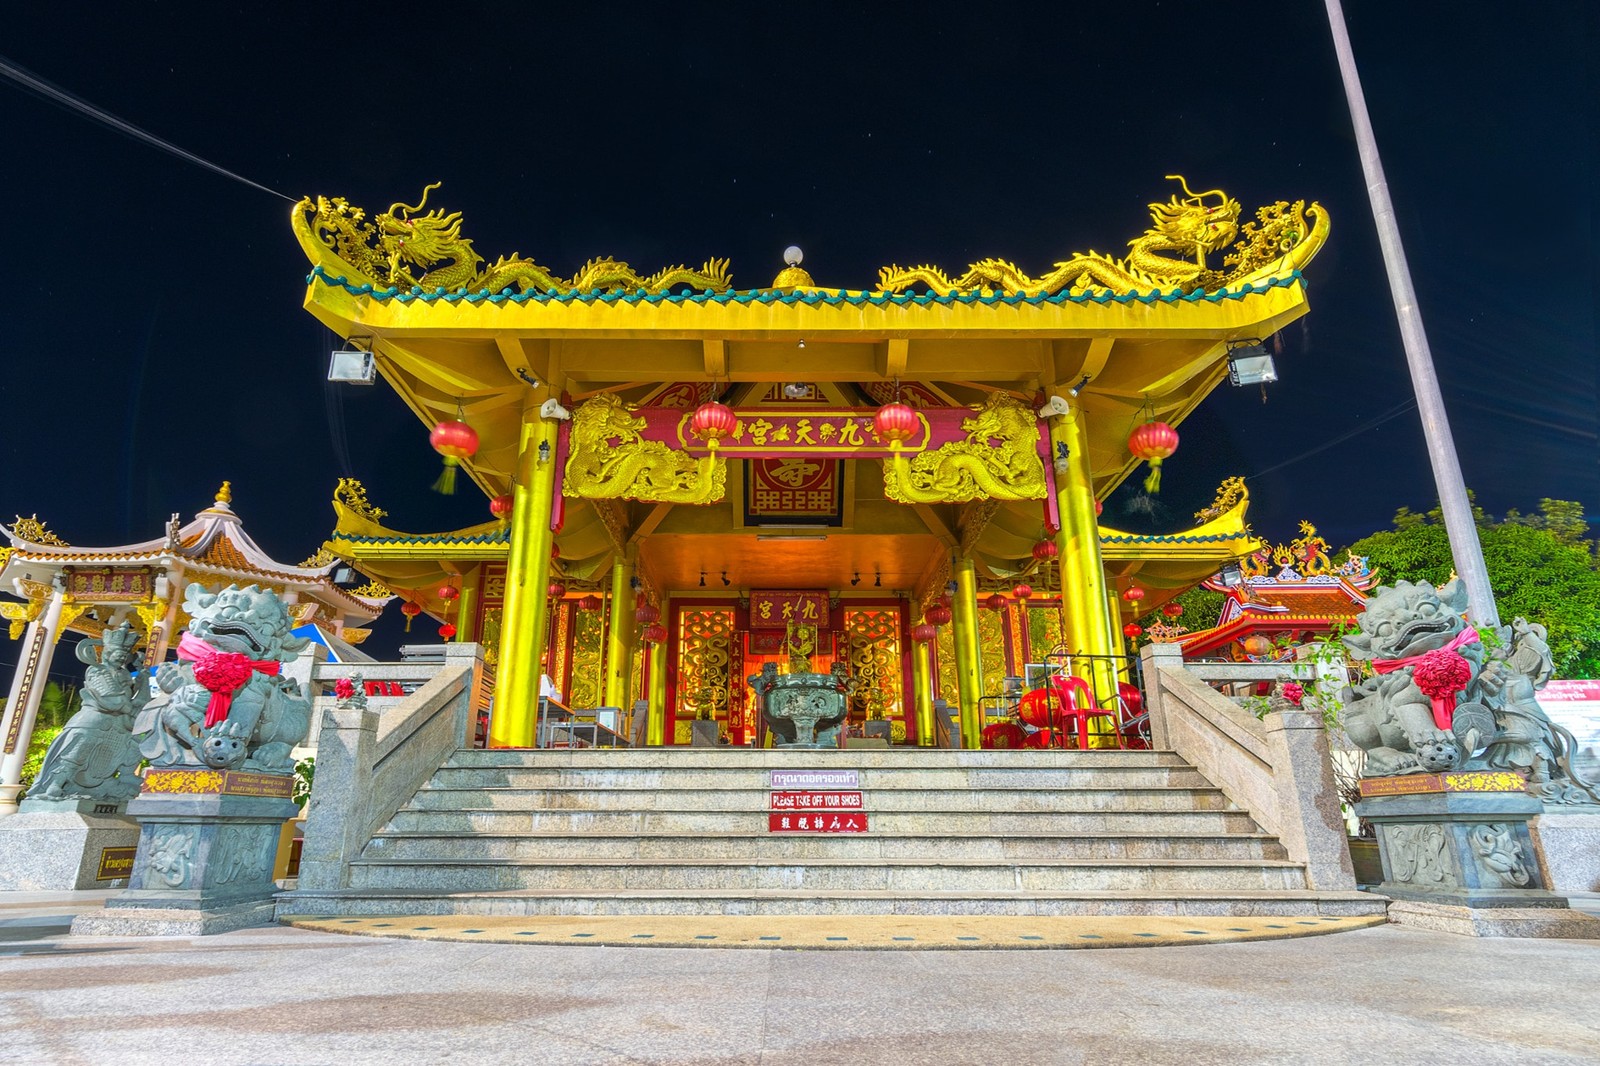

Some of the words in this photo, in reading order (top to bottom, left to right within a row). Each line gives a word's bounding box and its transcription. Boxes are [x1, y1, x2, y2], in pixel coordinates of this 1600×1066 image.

[773, 795, 795, 806] PLEASE
[795, 795, 811, 806] TAKE
[812, 795, 823, 806] OFF
[824, 795, 840, 806] YOUR
[841, 795, 860, 806] SHOES
